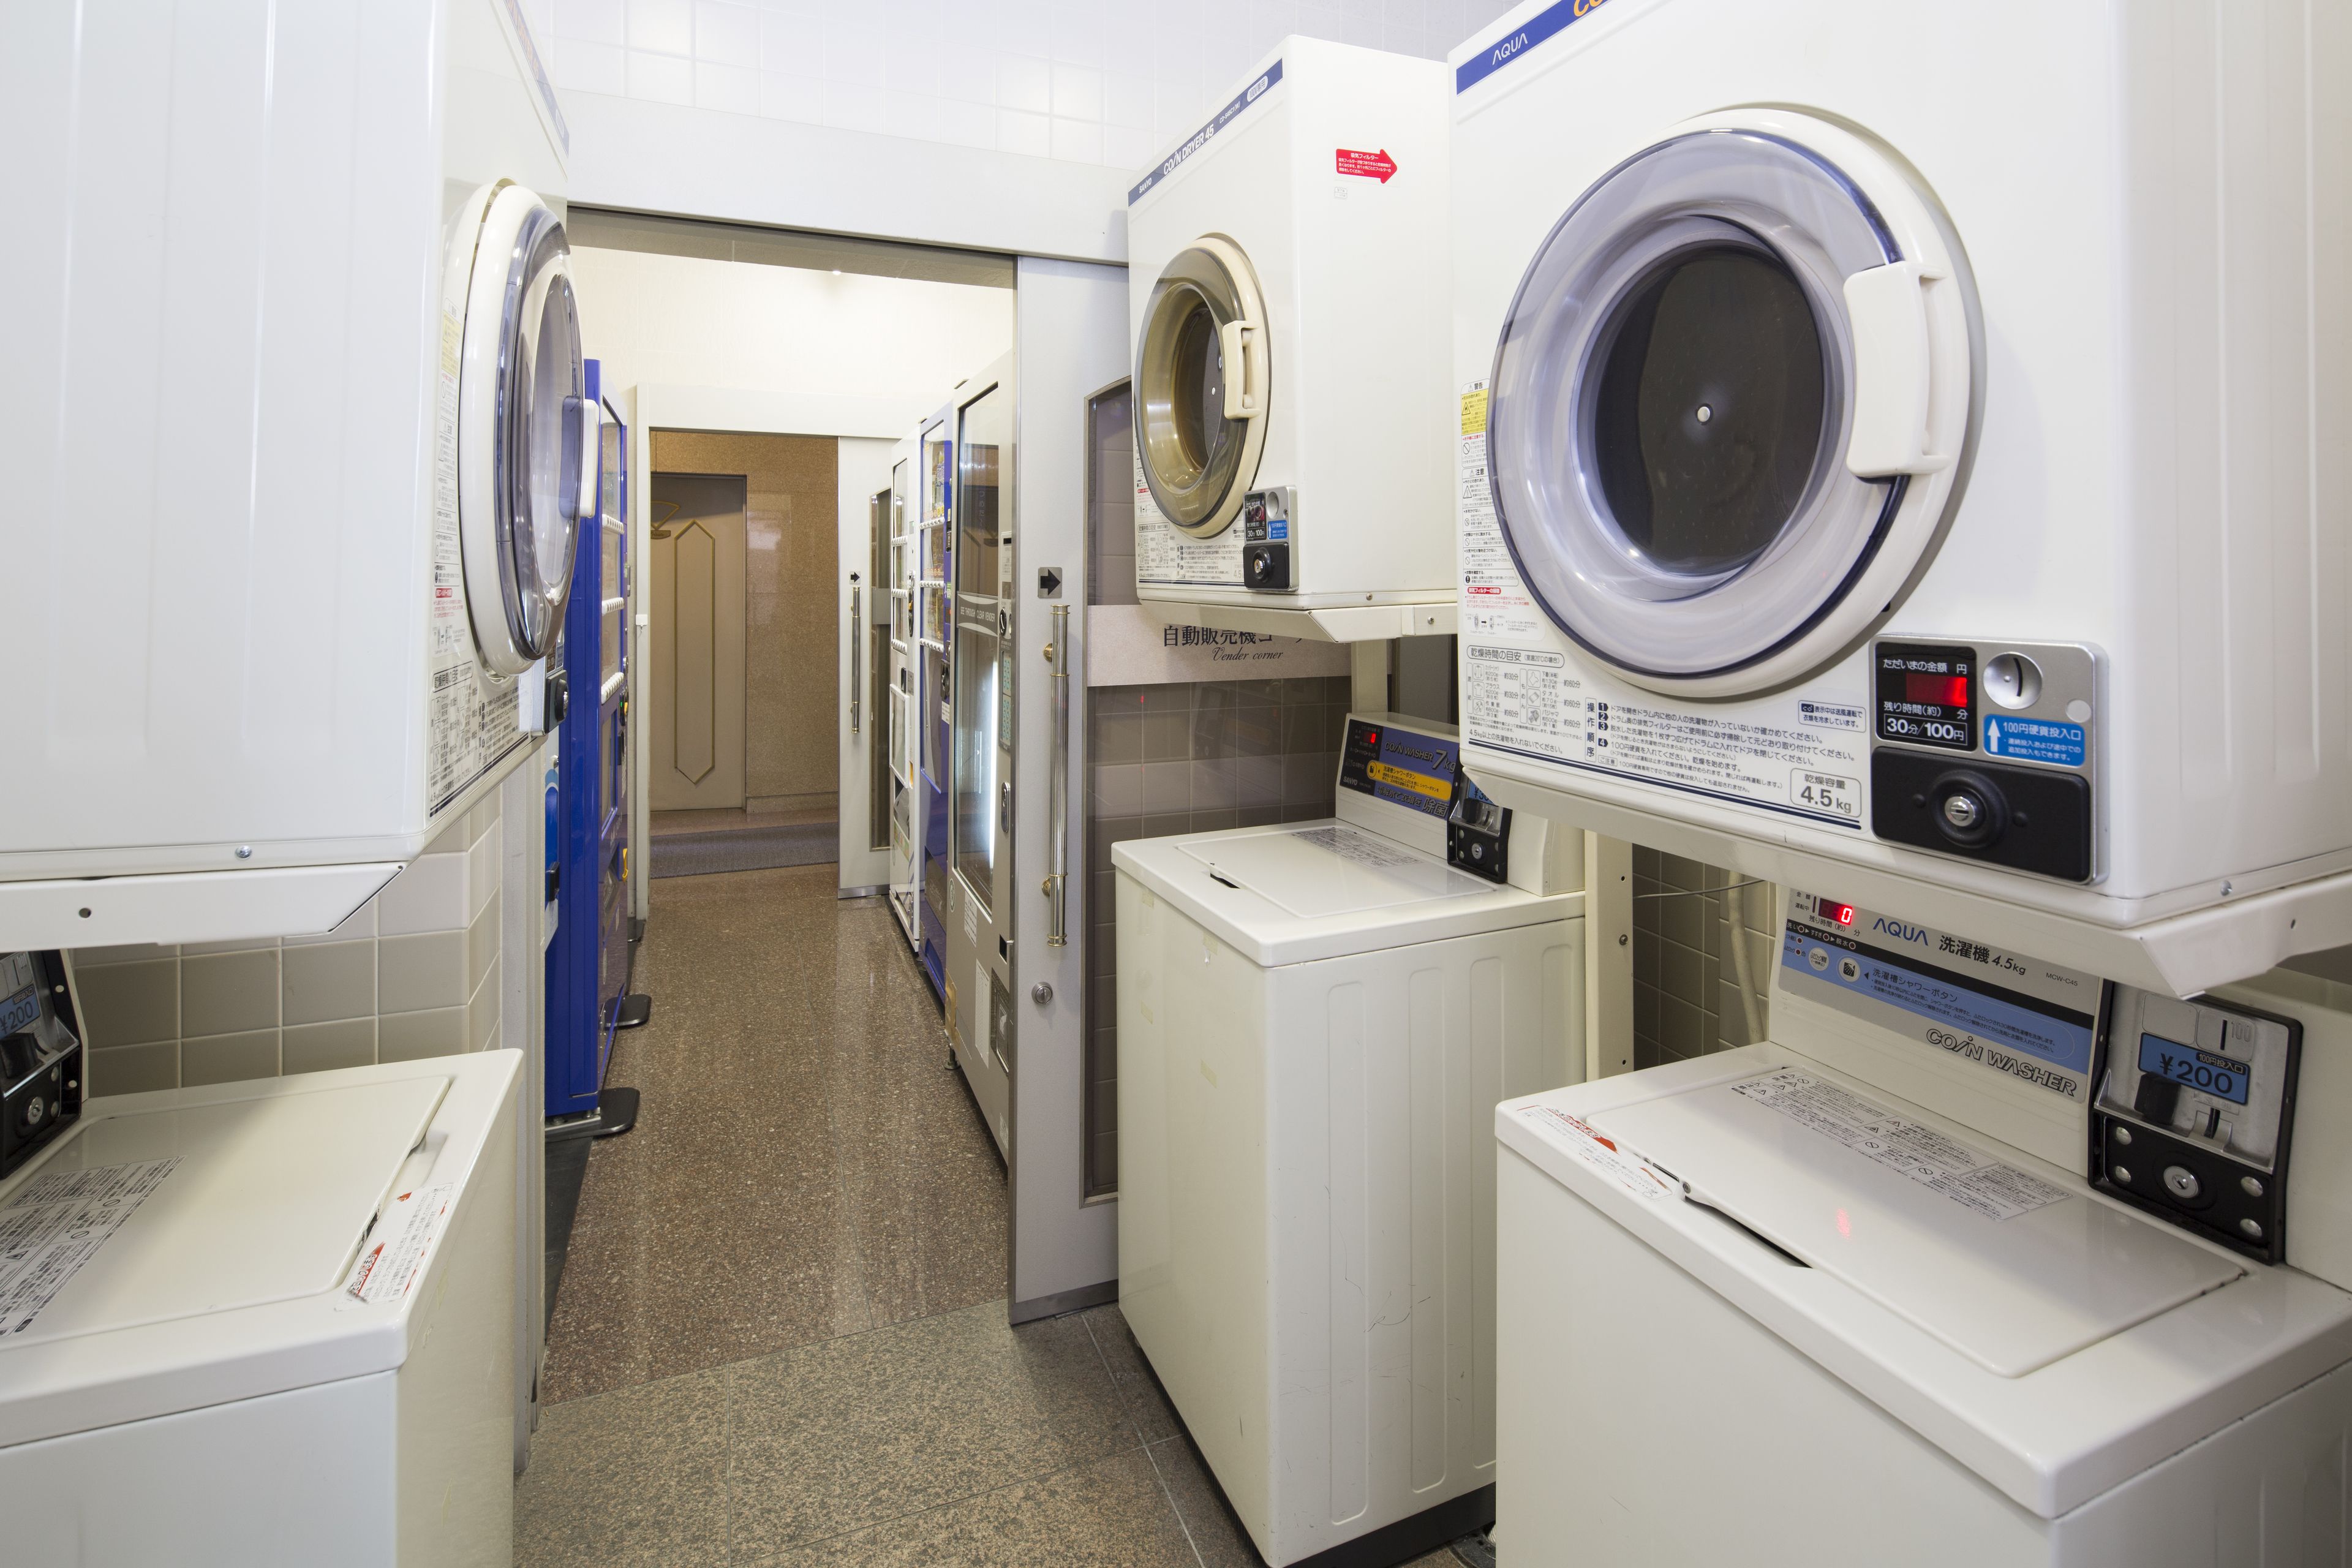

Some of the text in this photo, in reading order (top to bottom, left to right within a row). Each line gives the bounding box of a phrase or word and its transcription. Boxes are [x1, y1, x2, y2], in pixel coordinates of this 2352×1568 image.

[1493, 33, 1528, 65] AQUA
[1139, 178, 1152, 194] SANYO
[1182, 132, 1204, 160] DRYER
[1205, 124, 1214, 140] 45
[1212, 647, 1283, 662] Vender corner
[1471, 647, 1521, 662] 乾燥時間の目安
[1883, 658, 1967, 674] ただいまの金額 円
[1883, 701, 1968, 720] 残り時間(約) 分
[1586, 702, 1595, 758] 操作順序
[1887, 717, 1964, 741] 30分/100円
[2003, 722, 2081, 741] 100円硬貨投入口
[1403, 747, 1434, 762] WASHER
[1343, 776, 1358, 786] SANYO
[1804, 774, 1846, 790] 乾燥容量
[1422, 797, 1450, 817] 除菌
[1801, 785, 1852, 814] 4.5 kg
[1841, 907, 1853, 923] 0
[1853, 929, 1860, 937] 分
[1873, 918, 2078, 987] AQUA 洗濯機 4.5kg MCW-C45
[1872, 968, 1958, 1003] 洗濯槽シャワーボタン
[0, 1001, 33, 1034] ¥200
[1987, 1049, 2077, 1097] WASHER
[2159, 1052, 2233, 1095] ¥200
[2198, 1053, 2245, 1074] 100円投入口
